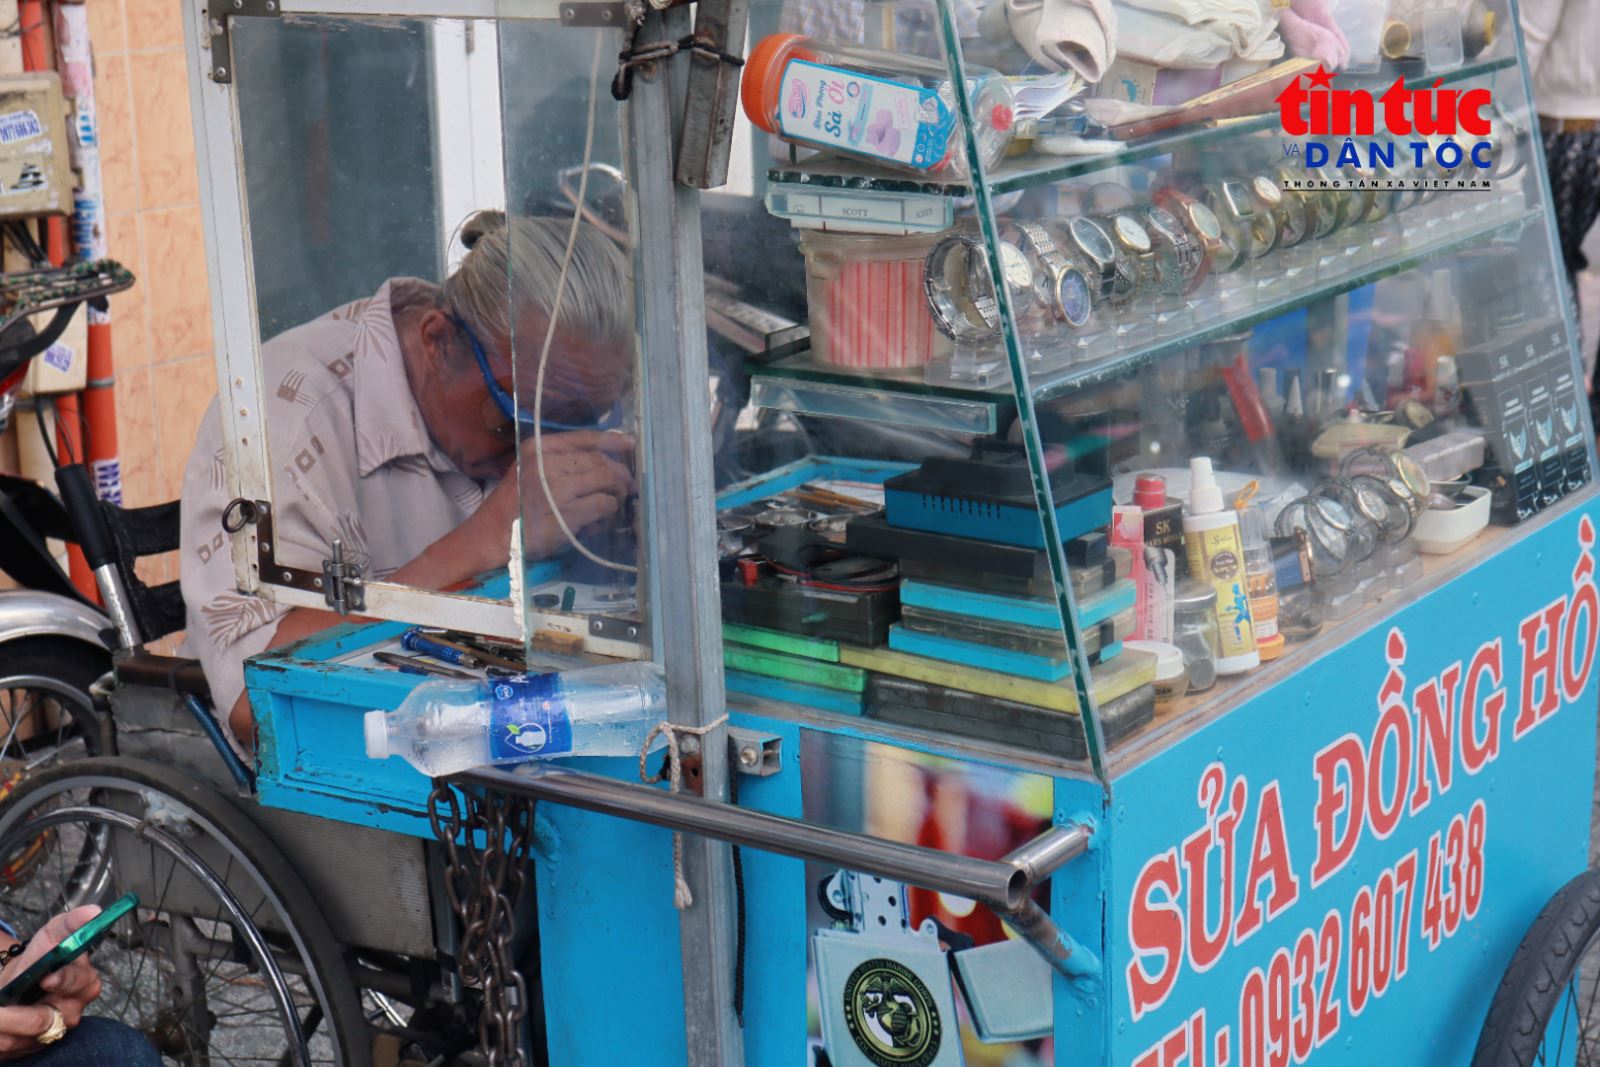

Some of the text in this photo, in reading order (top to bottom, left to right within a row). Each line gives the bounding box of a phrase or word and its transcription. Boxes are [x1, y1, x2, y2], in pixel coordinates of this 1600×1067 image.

[1155, 519, 1170, 535] SK
[1126, 514, 1600, 1022] SỬA ĐỒNG HỒ
[1239, 799, 1487, 1067] 0932 607 438
